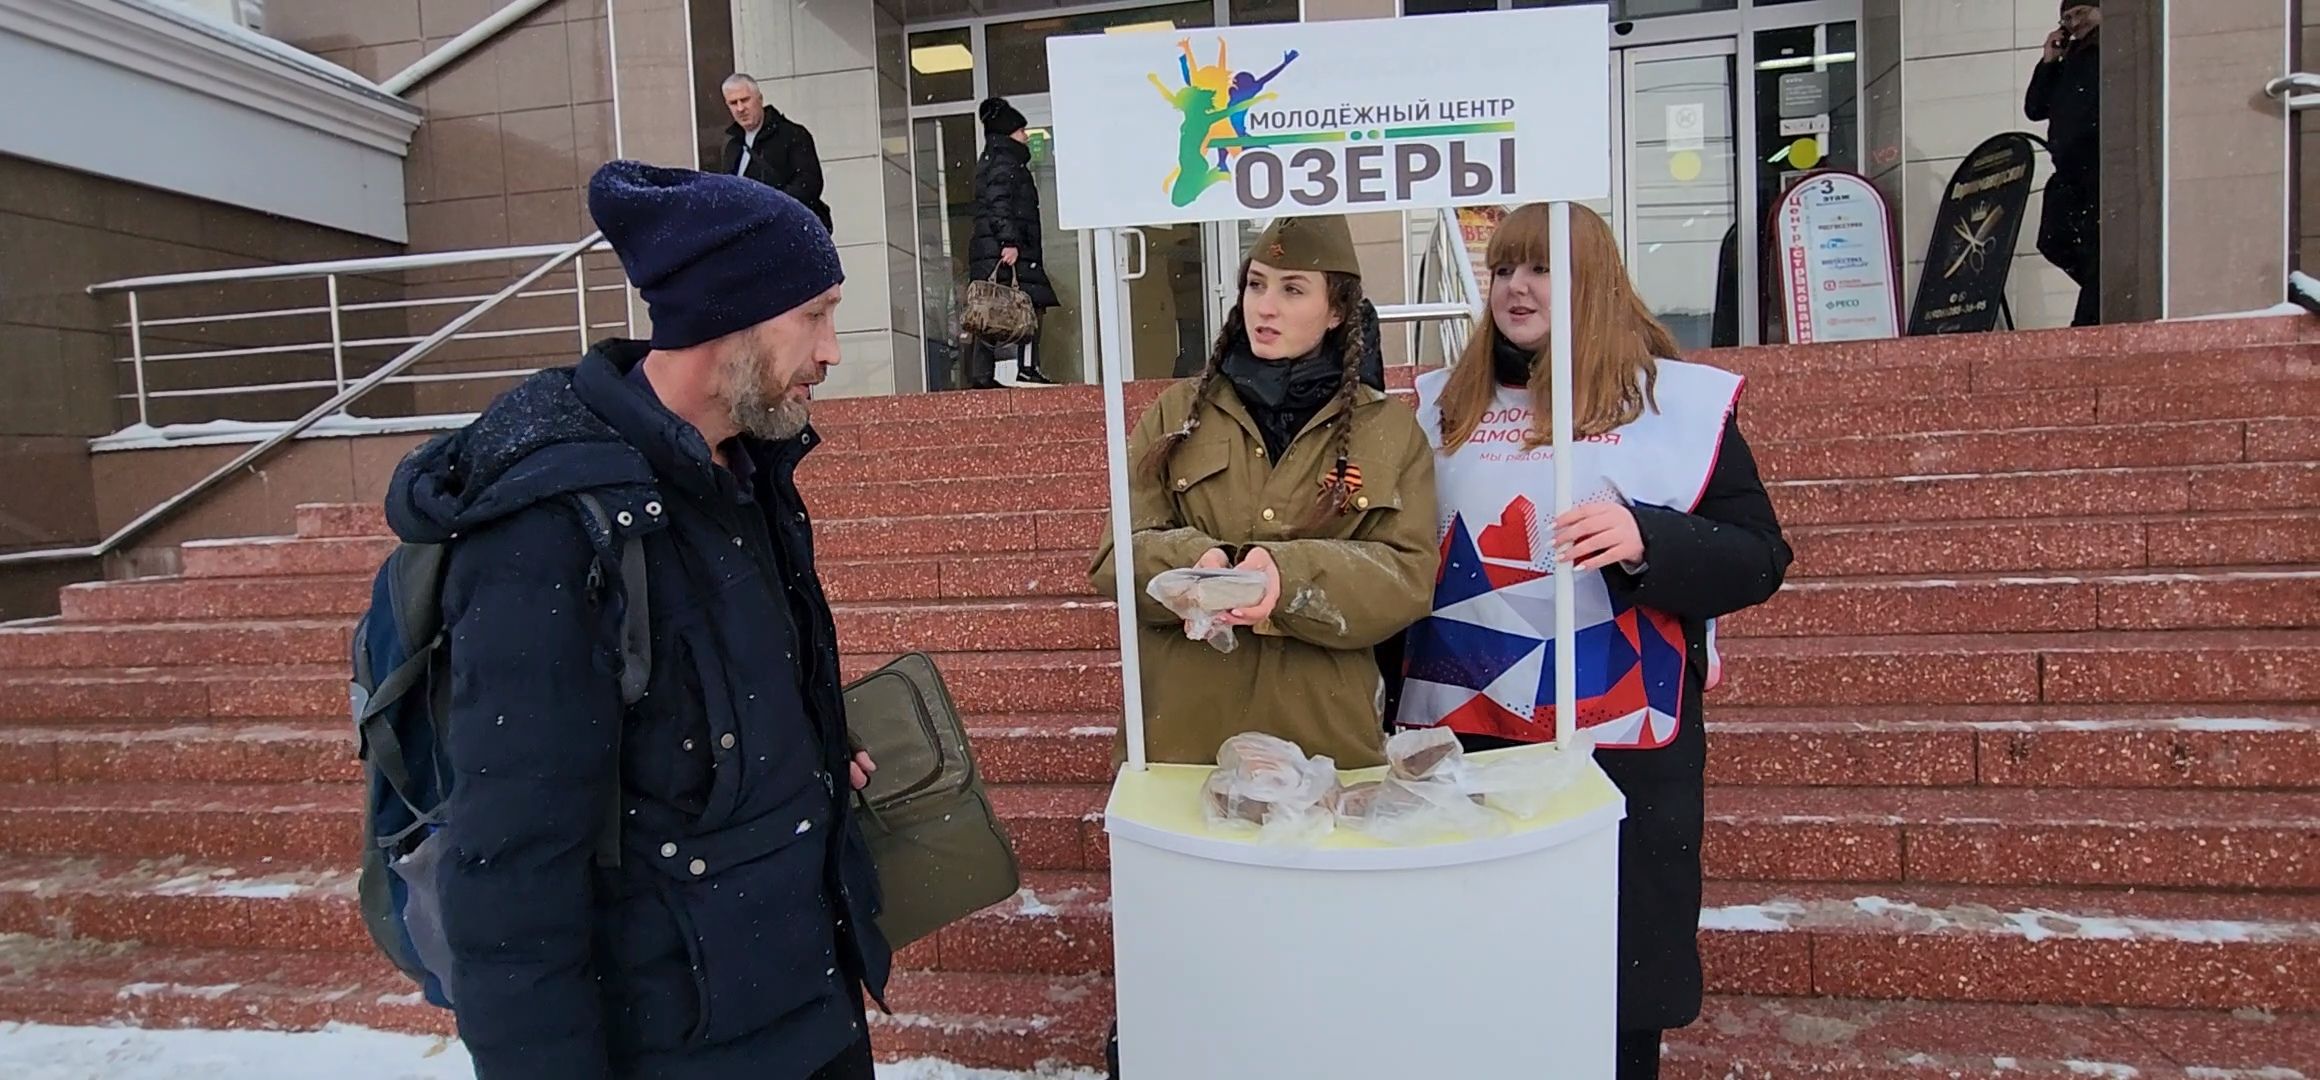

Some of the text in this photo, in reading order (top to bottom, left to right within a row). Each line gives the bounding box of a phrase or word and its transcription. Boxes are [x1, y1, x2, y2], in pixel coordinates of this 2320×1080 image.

[1249, 98, 1516, 131] МОЛОДЁЖНЫЙ ЦЕНТР
[1234, 129, 1518, 210] ОЗЁРЫ
[1820, 179, 1835, 195] 3
[1463, 225, 1495, 241] ВЕТ
[1480, 407, 1535, 424] ОЛОН
